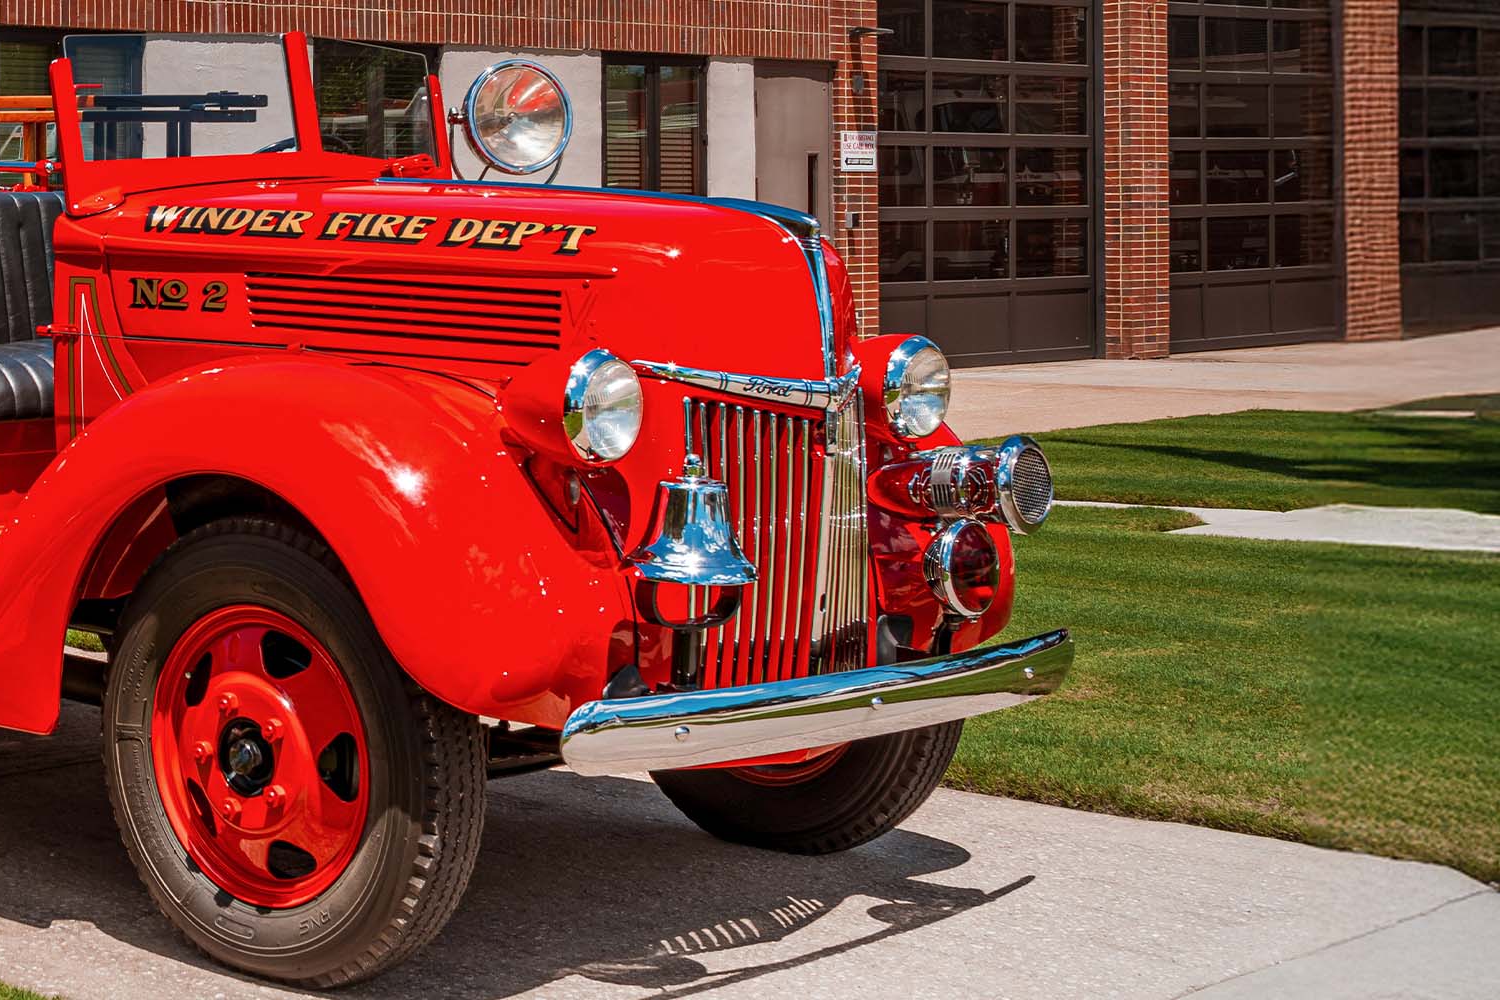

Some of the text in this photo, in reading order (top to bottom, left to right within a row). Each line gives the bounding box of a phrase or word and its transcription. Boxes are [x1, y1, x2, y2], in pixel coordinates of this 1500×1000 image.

[145, 205, 597, 256] WINDER FIRE DEP'T
[201, 280, 229, 312] 2
[743, 376, 792, 397] Ford
